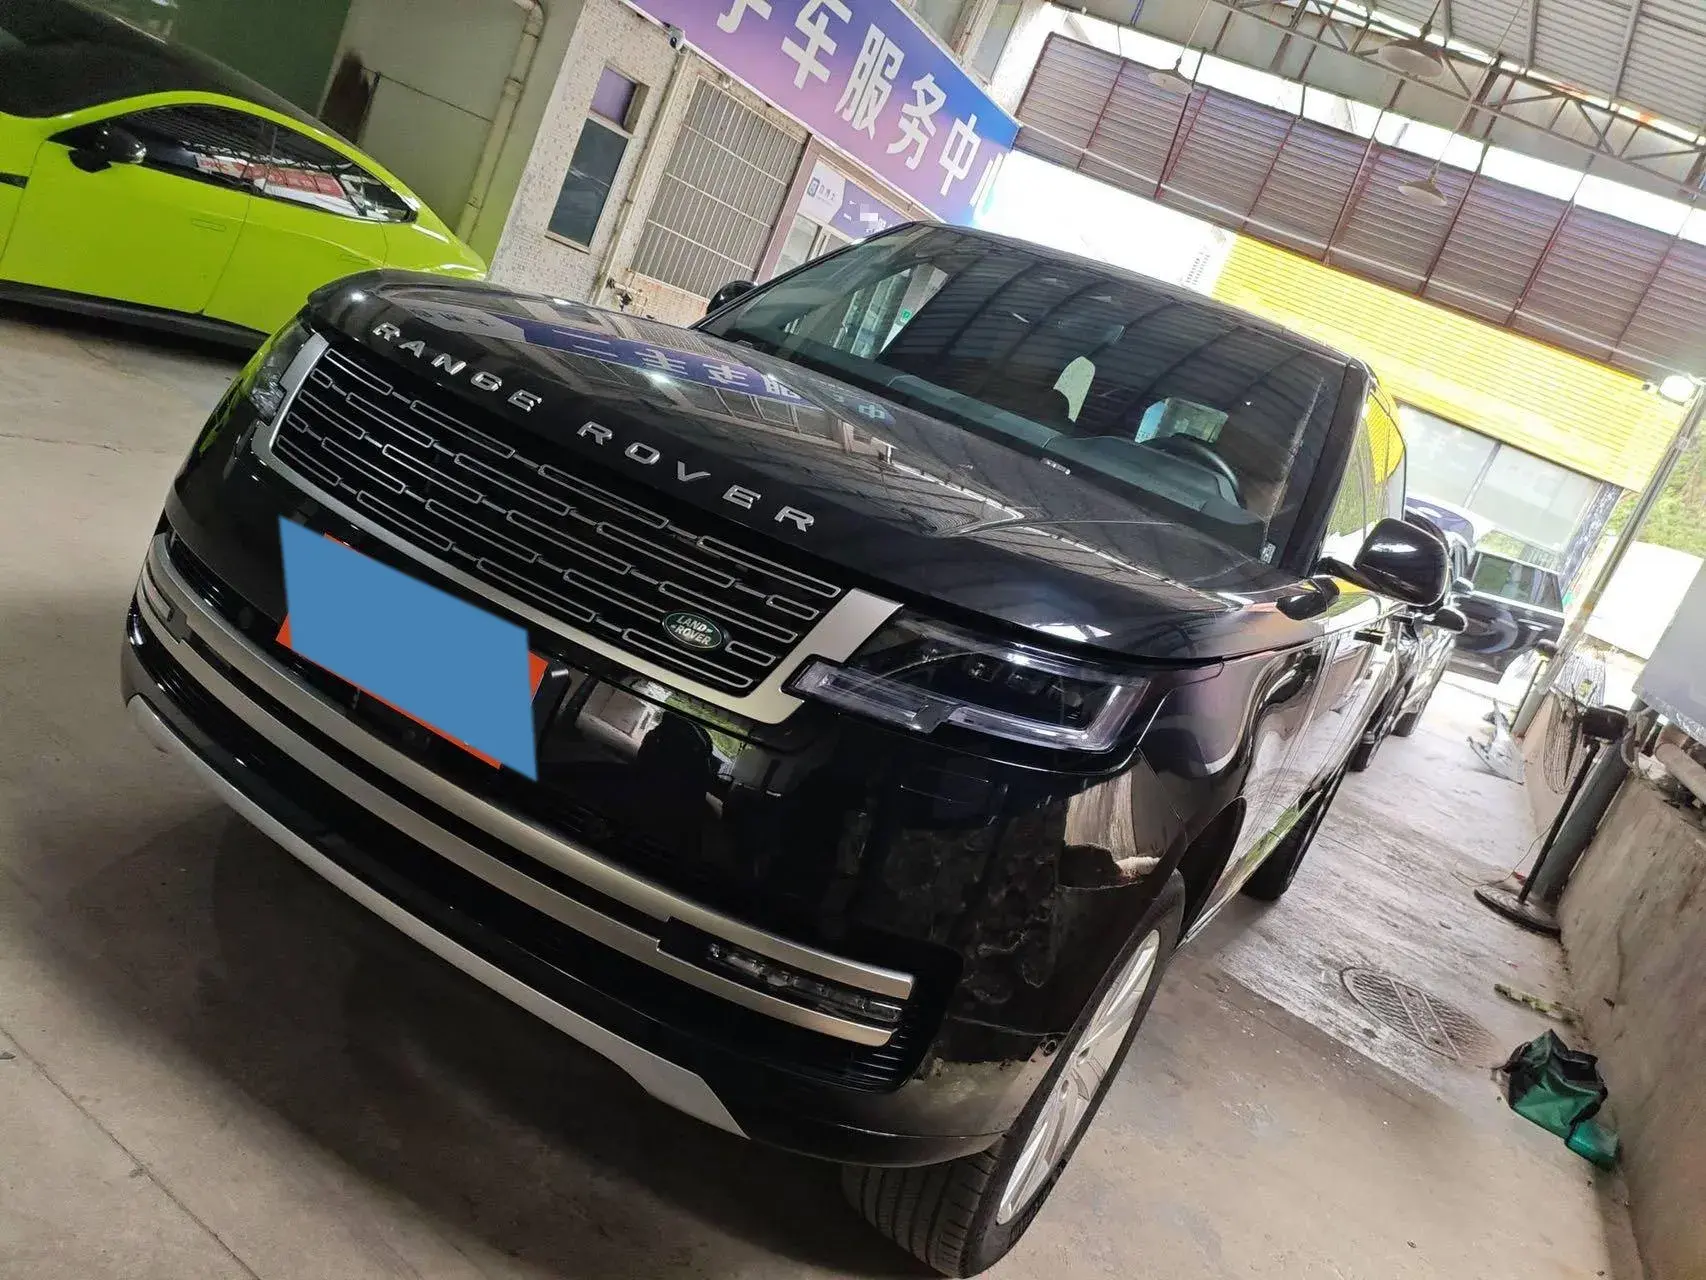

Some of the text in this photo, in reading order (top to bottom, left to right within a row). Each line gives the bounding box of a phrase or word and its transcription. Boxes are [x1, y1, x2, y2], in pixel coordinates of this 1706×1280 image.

[373, 322, 815, 532] RANGE ROVER
[676, 615, 707, 632] LAND
[674, 624, 712, 645] ROVER
